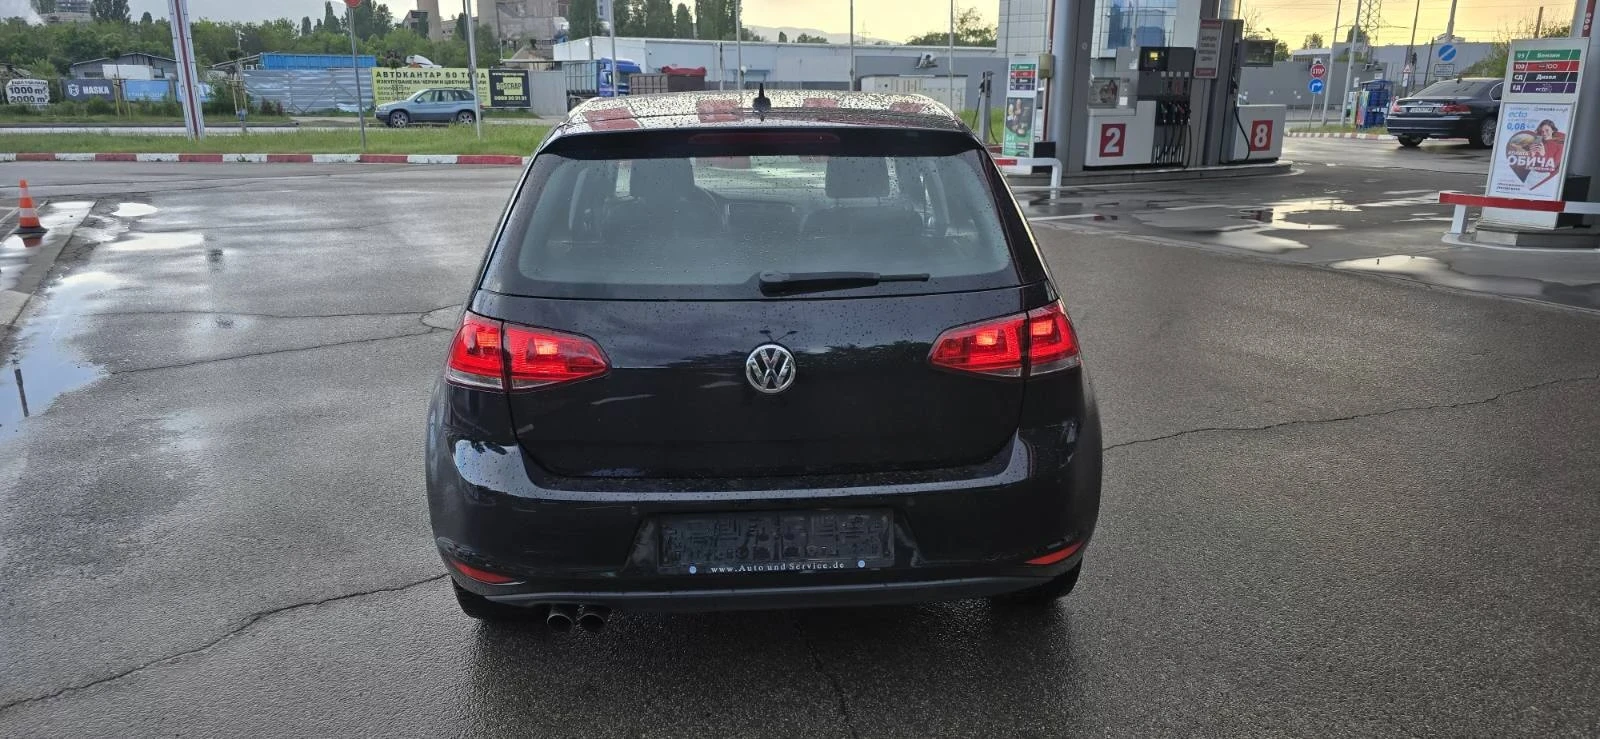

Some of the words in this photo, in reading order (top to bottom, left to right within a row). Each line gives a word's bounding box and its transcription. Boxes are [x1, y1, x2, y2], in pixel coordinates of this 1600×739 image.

[9, 86, 33, 94] 1000
[10, 95, 35, 103] 2000
[1507, 123, 1526, 131] 0,08
[1103, 127, 1121, 153] 2
[1254, 124, 1268, 148] 8
[1507, 155, 1555, 168] ОБИЧА
[711, 564, 764, 573] www.Auto
[767, 563, 786, 571] und
[789, 562, 845, 570] Service.de
